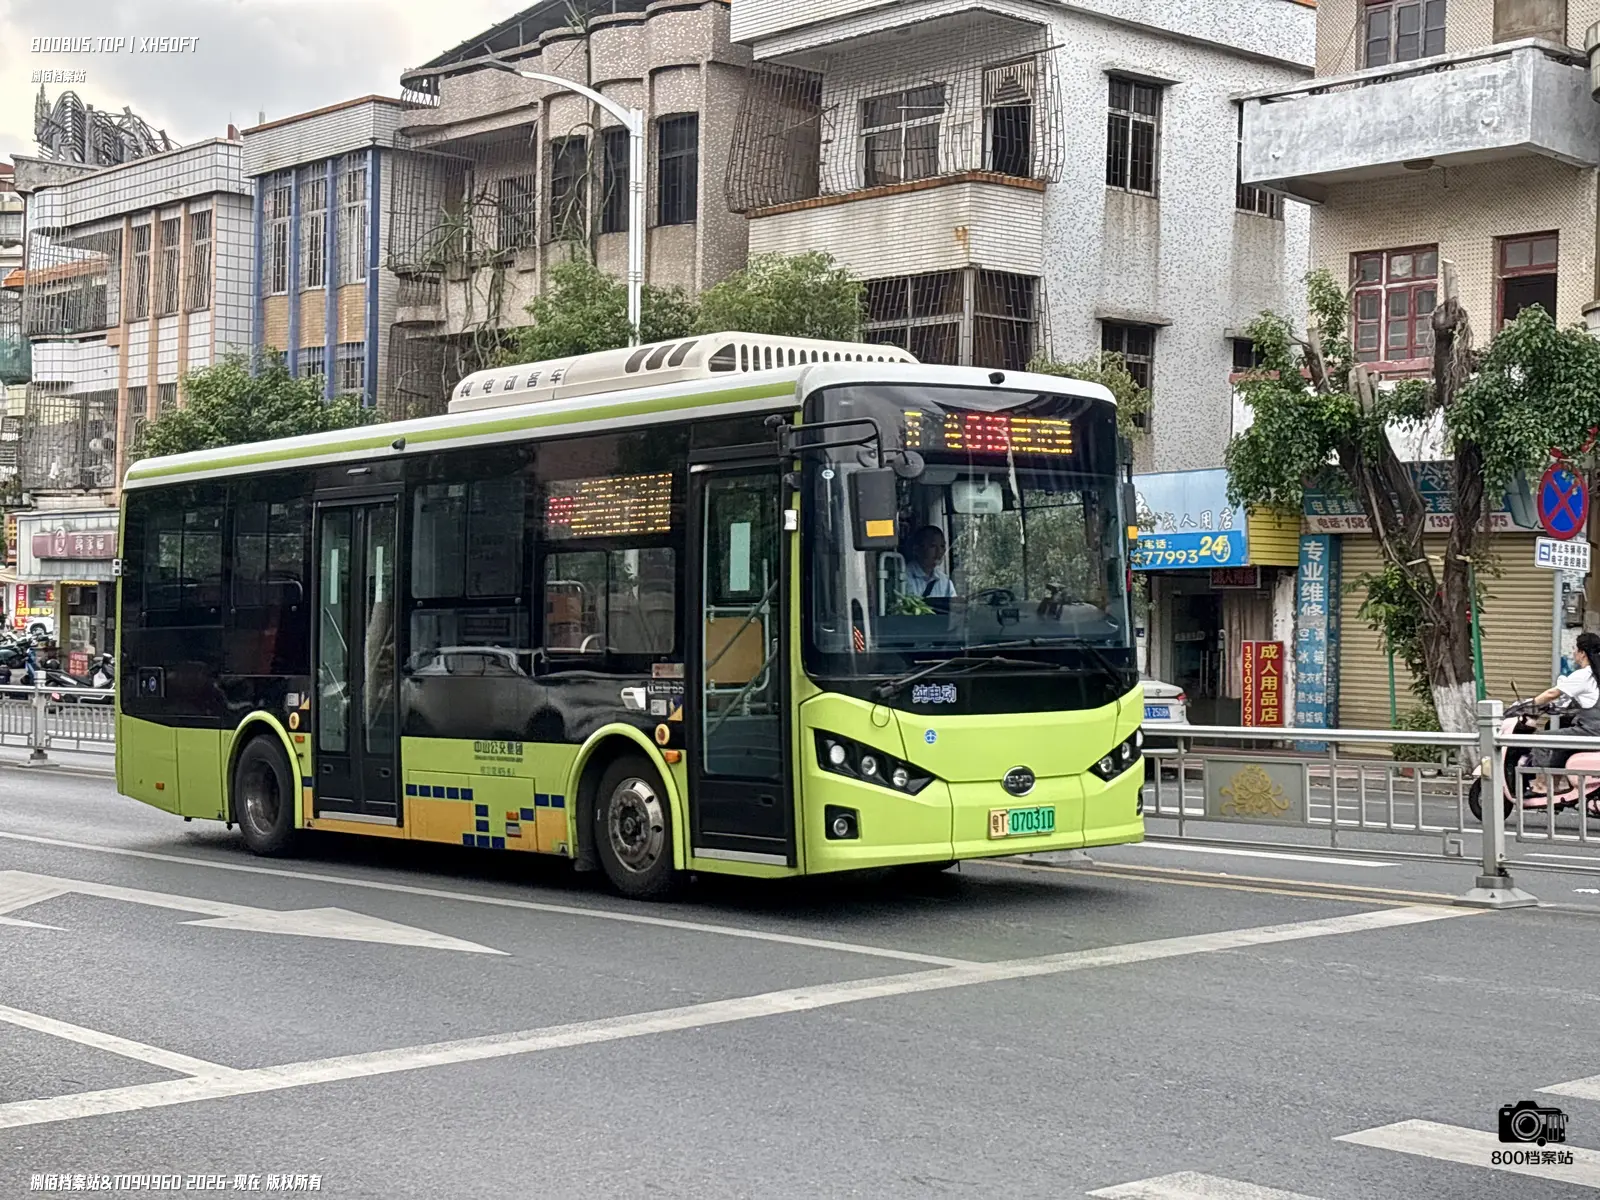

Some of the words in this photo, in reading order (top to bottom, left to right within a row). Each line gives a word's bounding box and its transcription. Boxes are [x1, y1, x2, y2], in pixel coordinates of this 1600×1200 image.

[460, 368, 565, 397] 纯电动客车
[1300, 540, 1325, 617] 专业维修
[912, 683, 957, 703] 纯电动
[1260, 644, 1279, 722] 成人用品店
